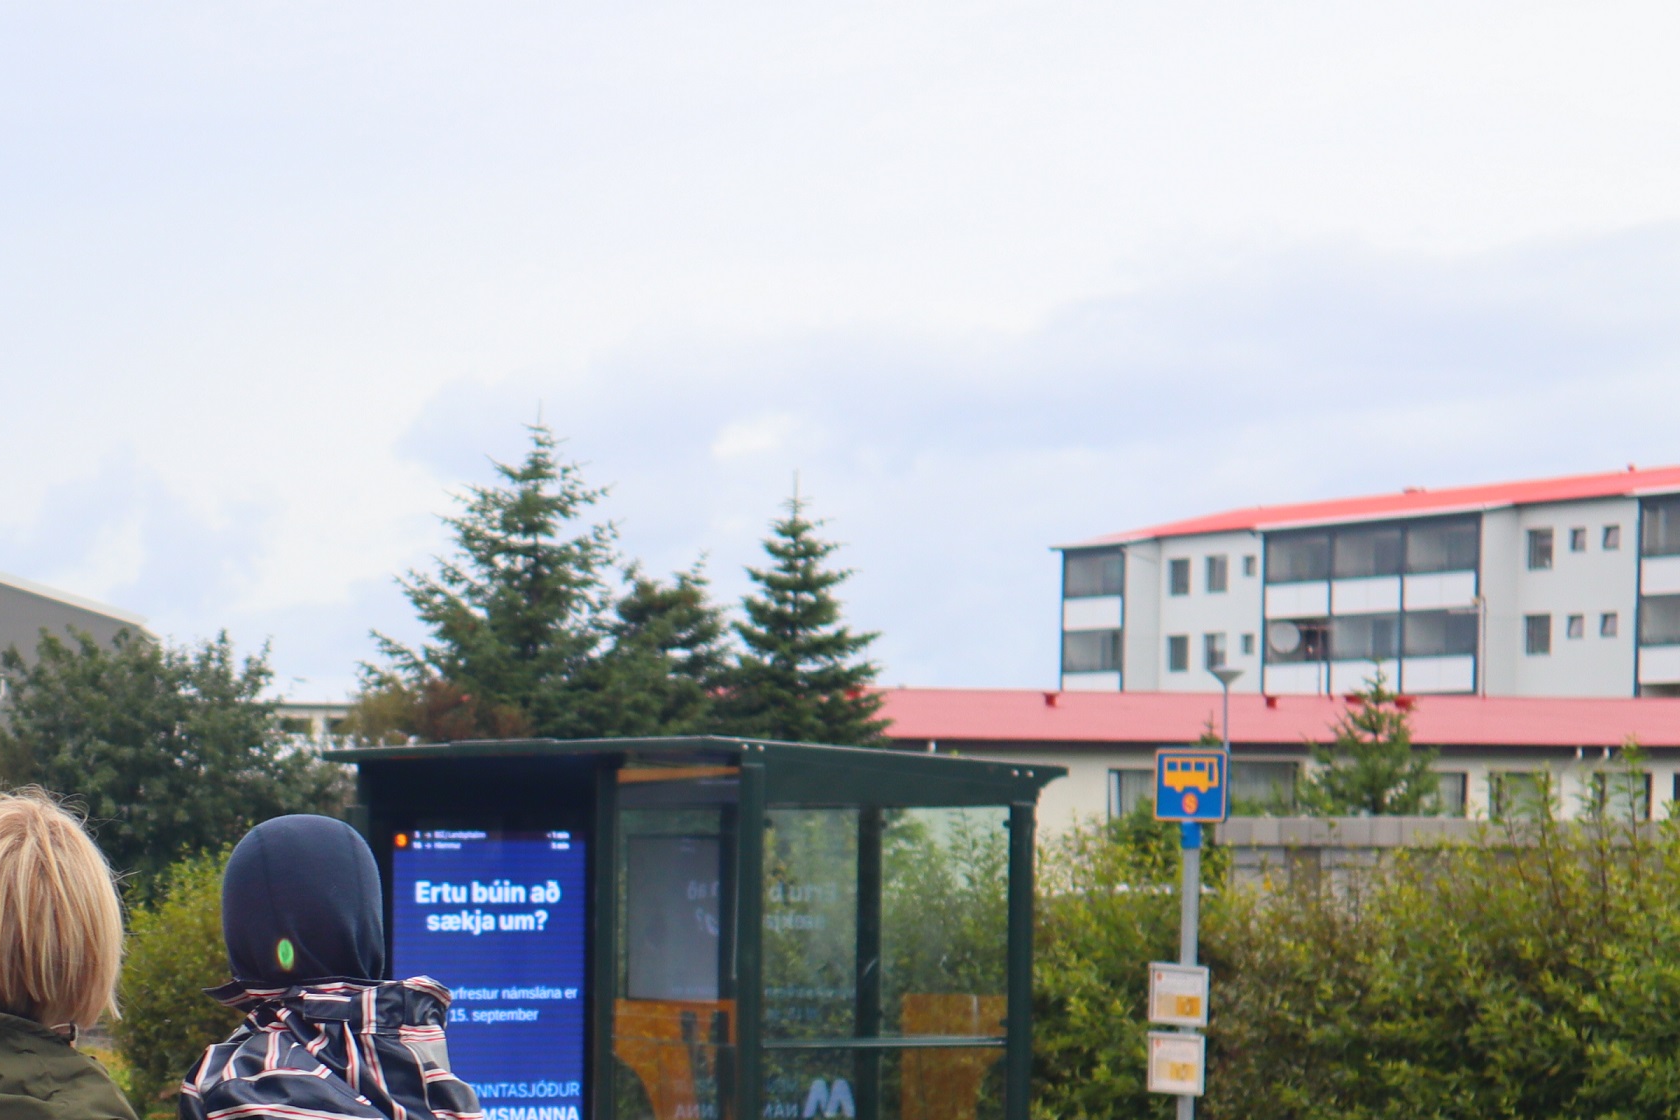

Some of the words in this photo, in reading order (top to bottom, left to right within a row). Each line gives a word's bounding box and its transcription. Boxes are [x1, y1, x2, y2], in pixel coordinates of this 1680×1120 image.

[415, 880, 467, 903] Ertu
[472, 879, 526, 903] búin
[530, 880, 561, 903] að
[426, 909, 495, 935] sækja
[499, 910, 548, 931] um?
[450, 987, 498, 999] arfrestur
[502, 987, 562, 999] námslána
[564, 988, 578, 999] er
[450, 1009, 469, 1022] 15.
[472, 1009, 539, 1024] september
